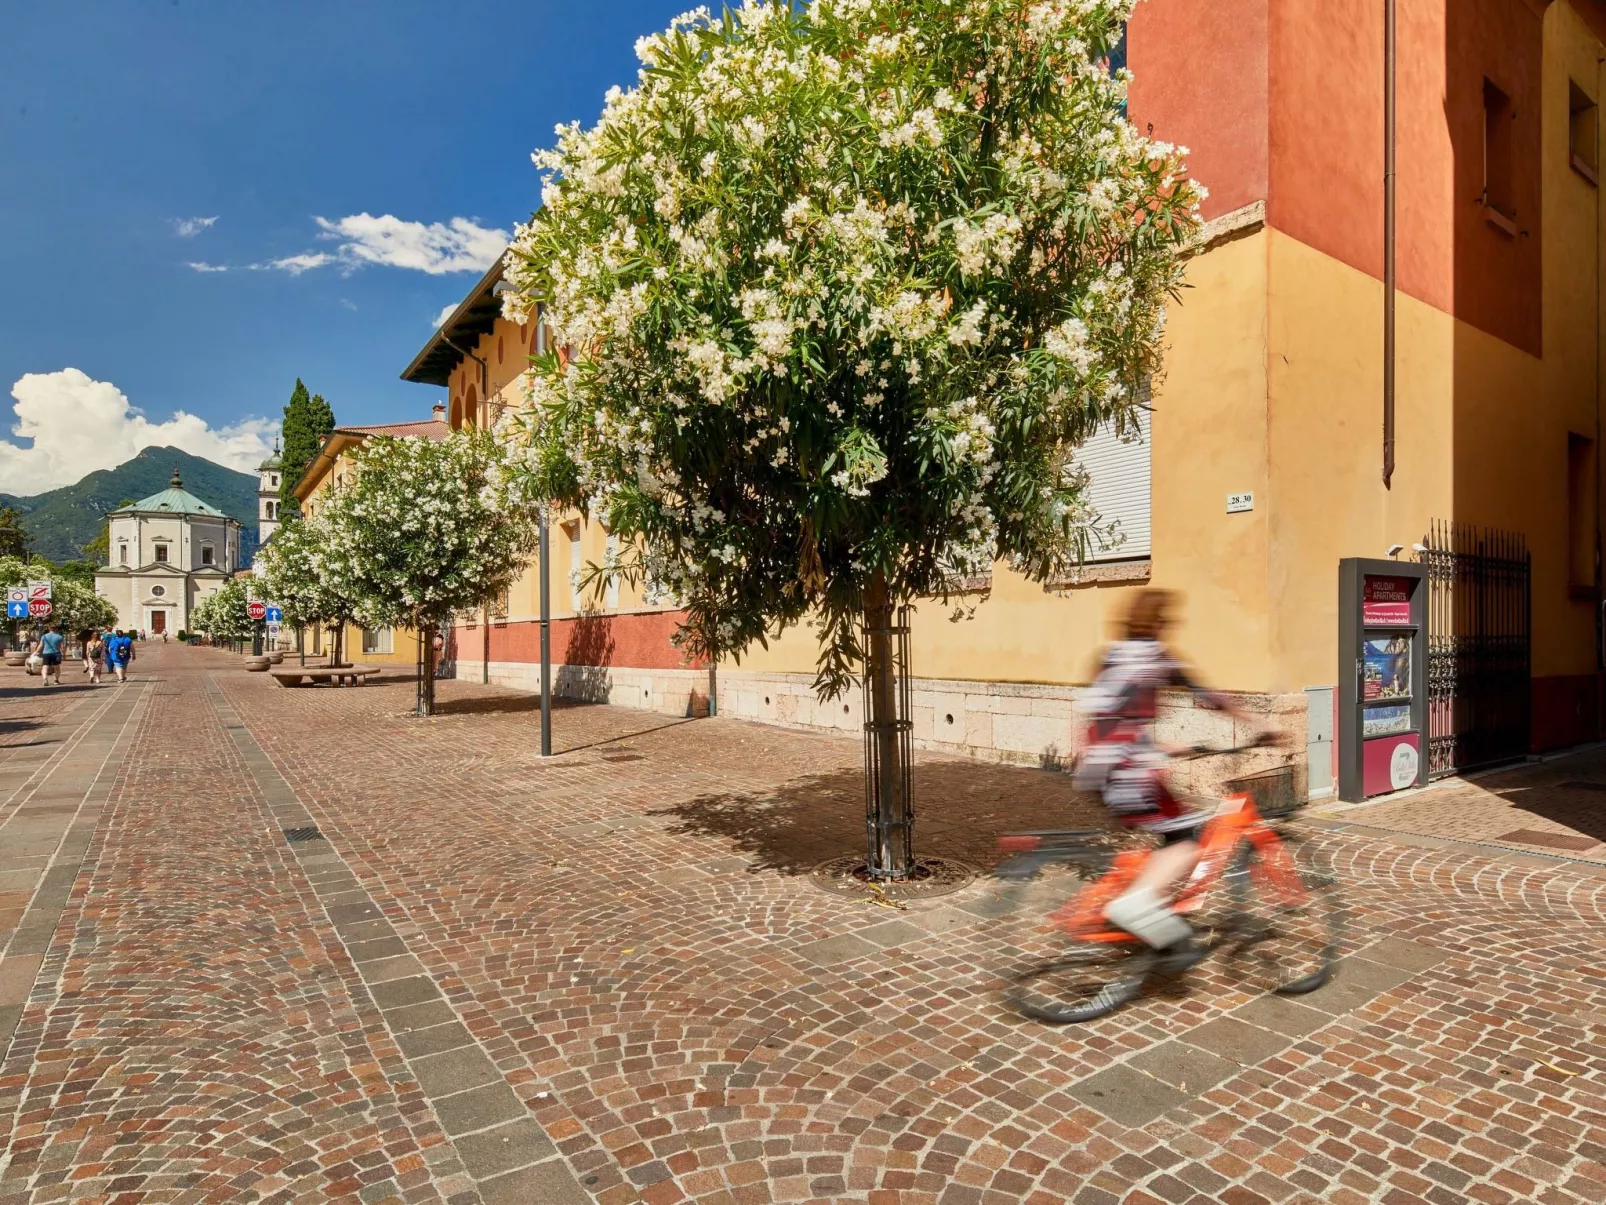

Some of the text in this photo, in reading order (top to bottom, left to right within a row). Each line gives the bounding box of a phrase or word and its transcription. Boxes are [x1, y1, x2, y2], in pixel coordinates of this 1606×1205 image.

[1372, 581, 1396, 591] HOLIDAY
[1372, 591, 1407, 601] APARTMENTS
[30, 604, 50, 612] STOP
[248, 607, 265, 615] STOP
